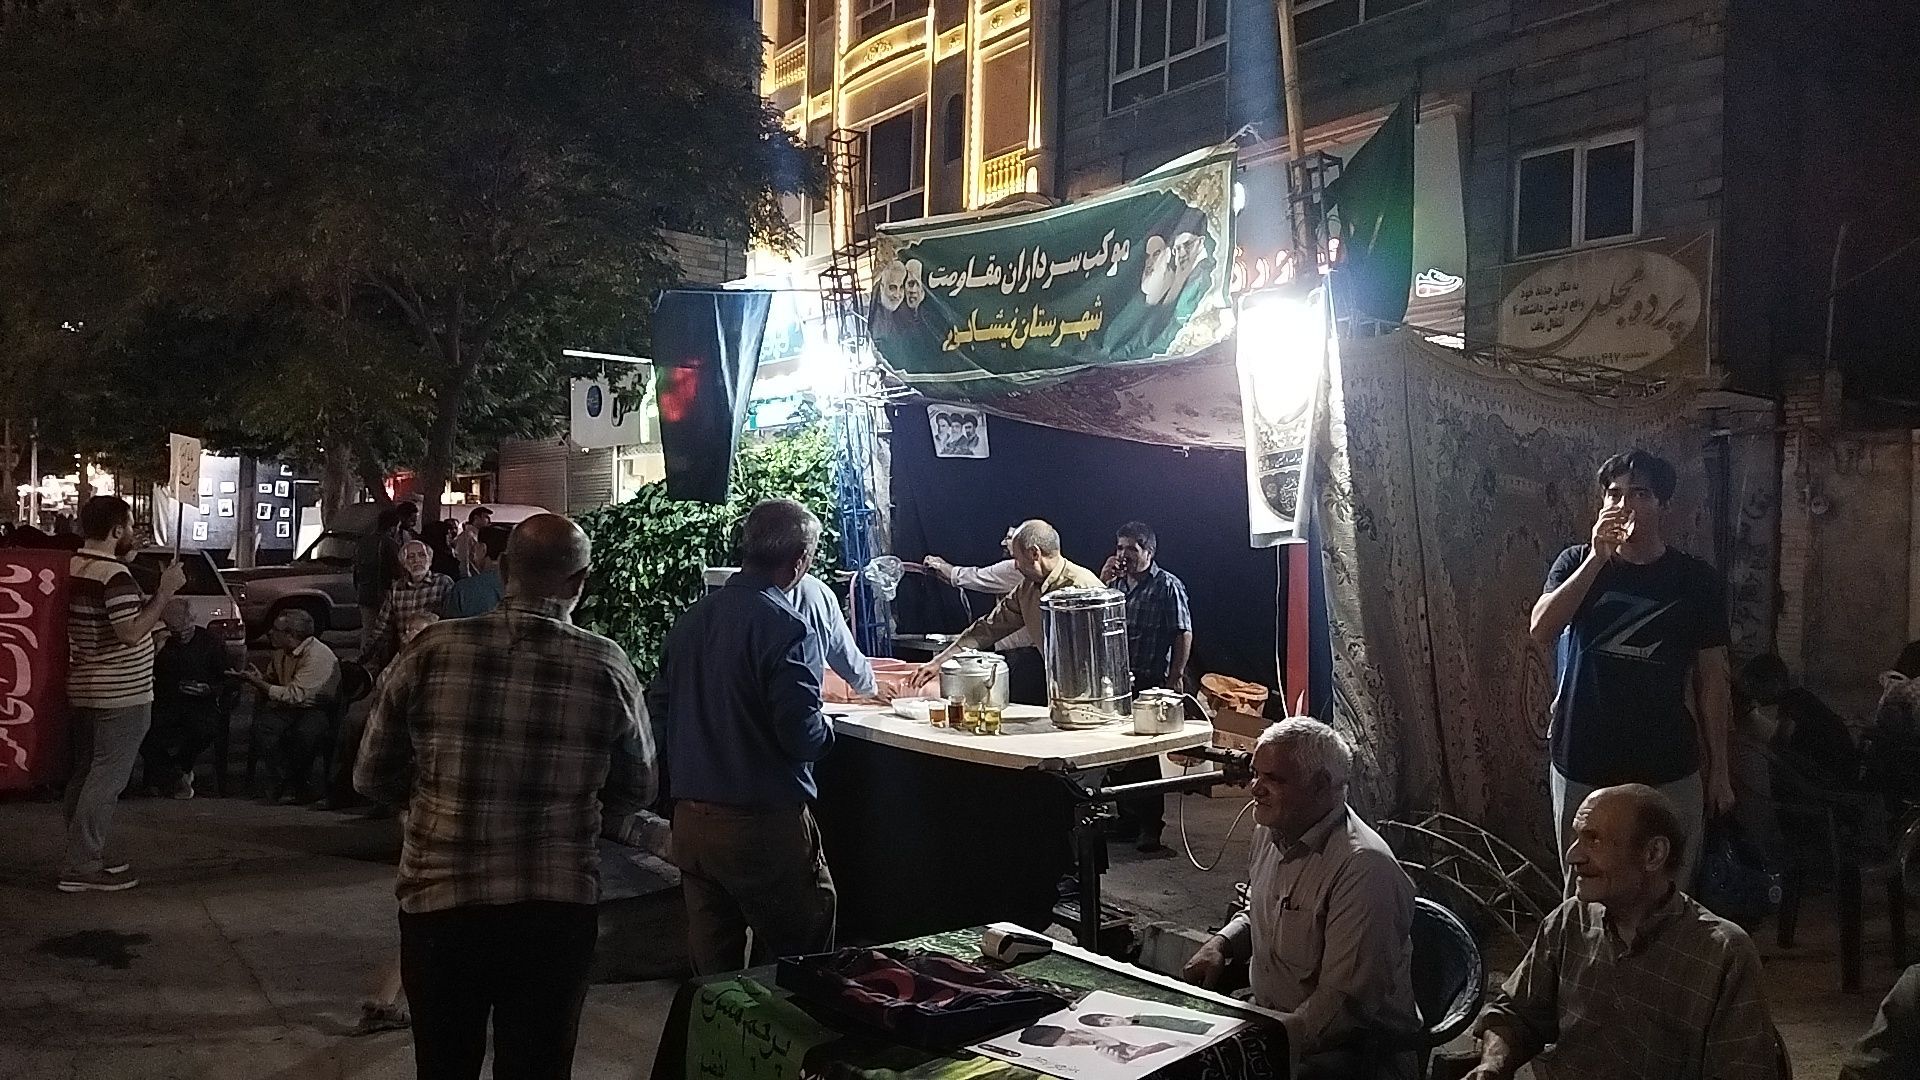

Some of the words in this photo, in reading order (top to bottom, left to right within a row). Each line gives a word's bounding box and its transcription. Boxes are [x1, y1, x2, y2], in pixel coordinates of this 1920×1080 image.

[927, 255, 1003, 297] مقاومت
[1001, 244, 1083, 295] سرداران
[1082, 228, 1131, 279] موکب
[943, 306, 1019, 352] نیشابور
[1011, 295, 1103, 350] شهرستان
